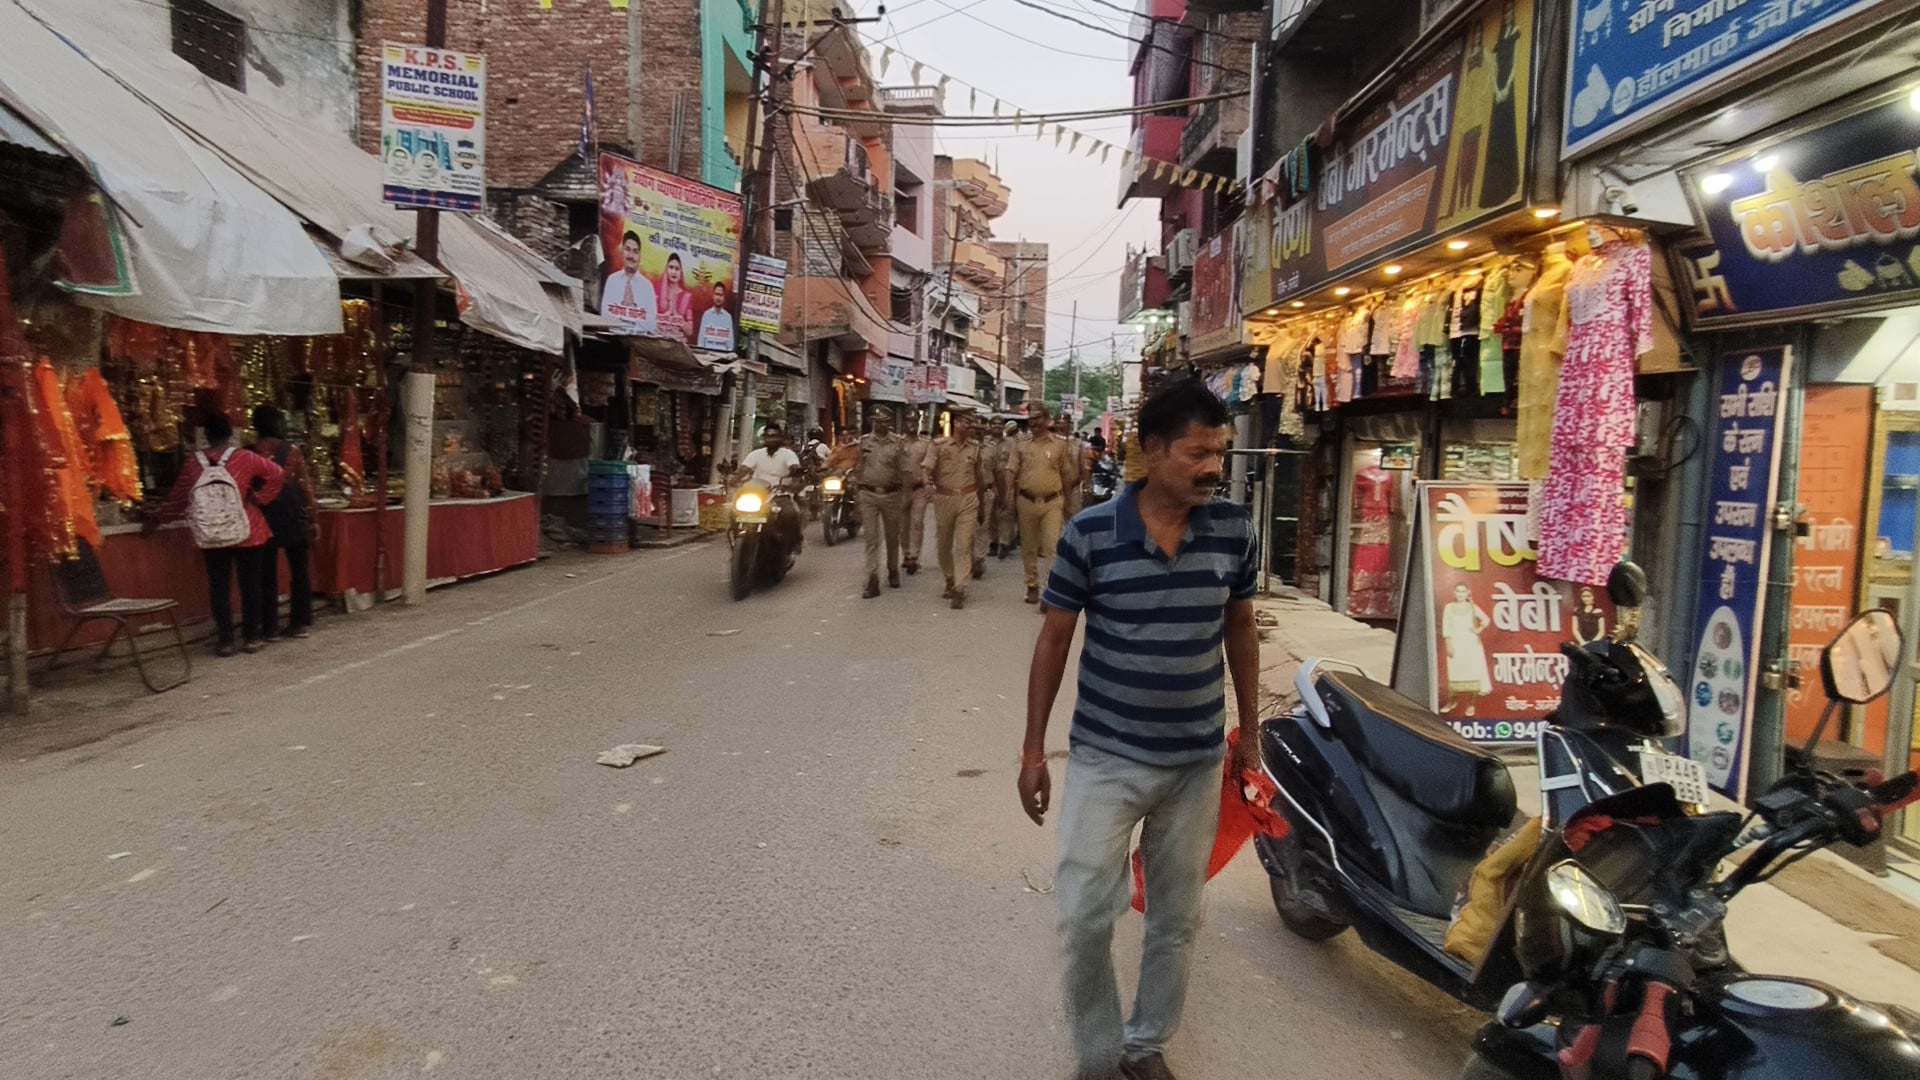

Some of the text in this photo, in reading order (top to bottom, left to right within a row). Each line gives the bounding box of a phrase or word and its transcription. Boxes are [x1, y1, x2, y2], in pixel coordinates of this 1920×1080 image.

[405, 49, 463, 72] K.P.S.
[387, 65, 479, 89] MEMORIAL
[387, 79, 430, 96] PUBLIC
[433, 86, 479, 102] SCHOOL
[1491, 582, 1563, 632] बेबी
